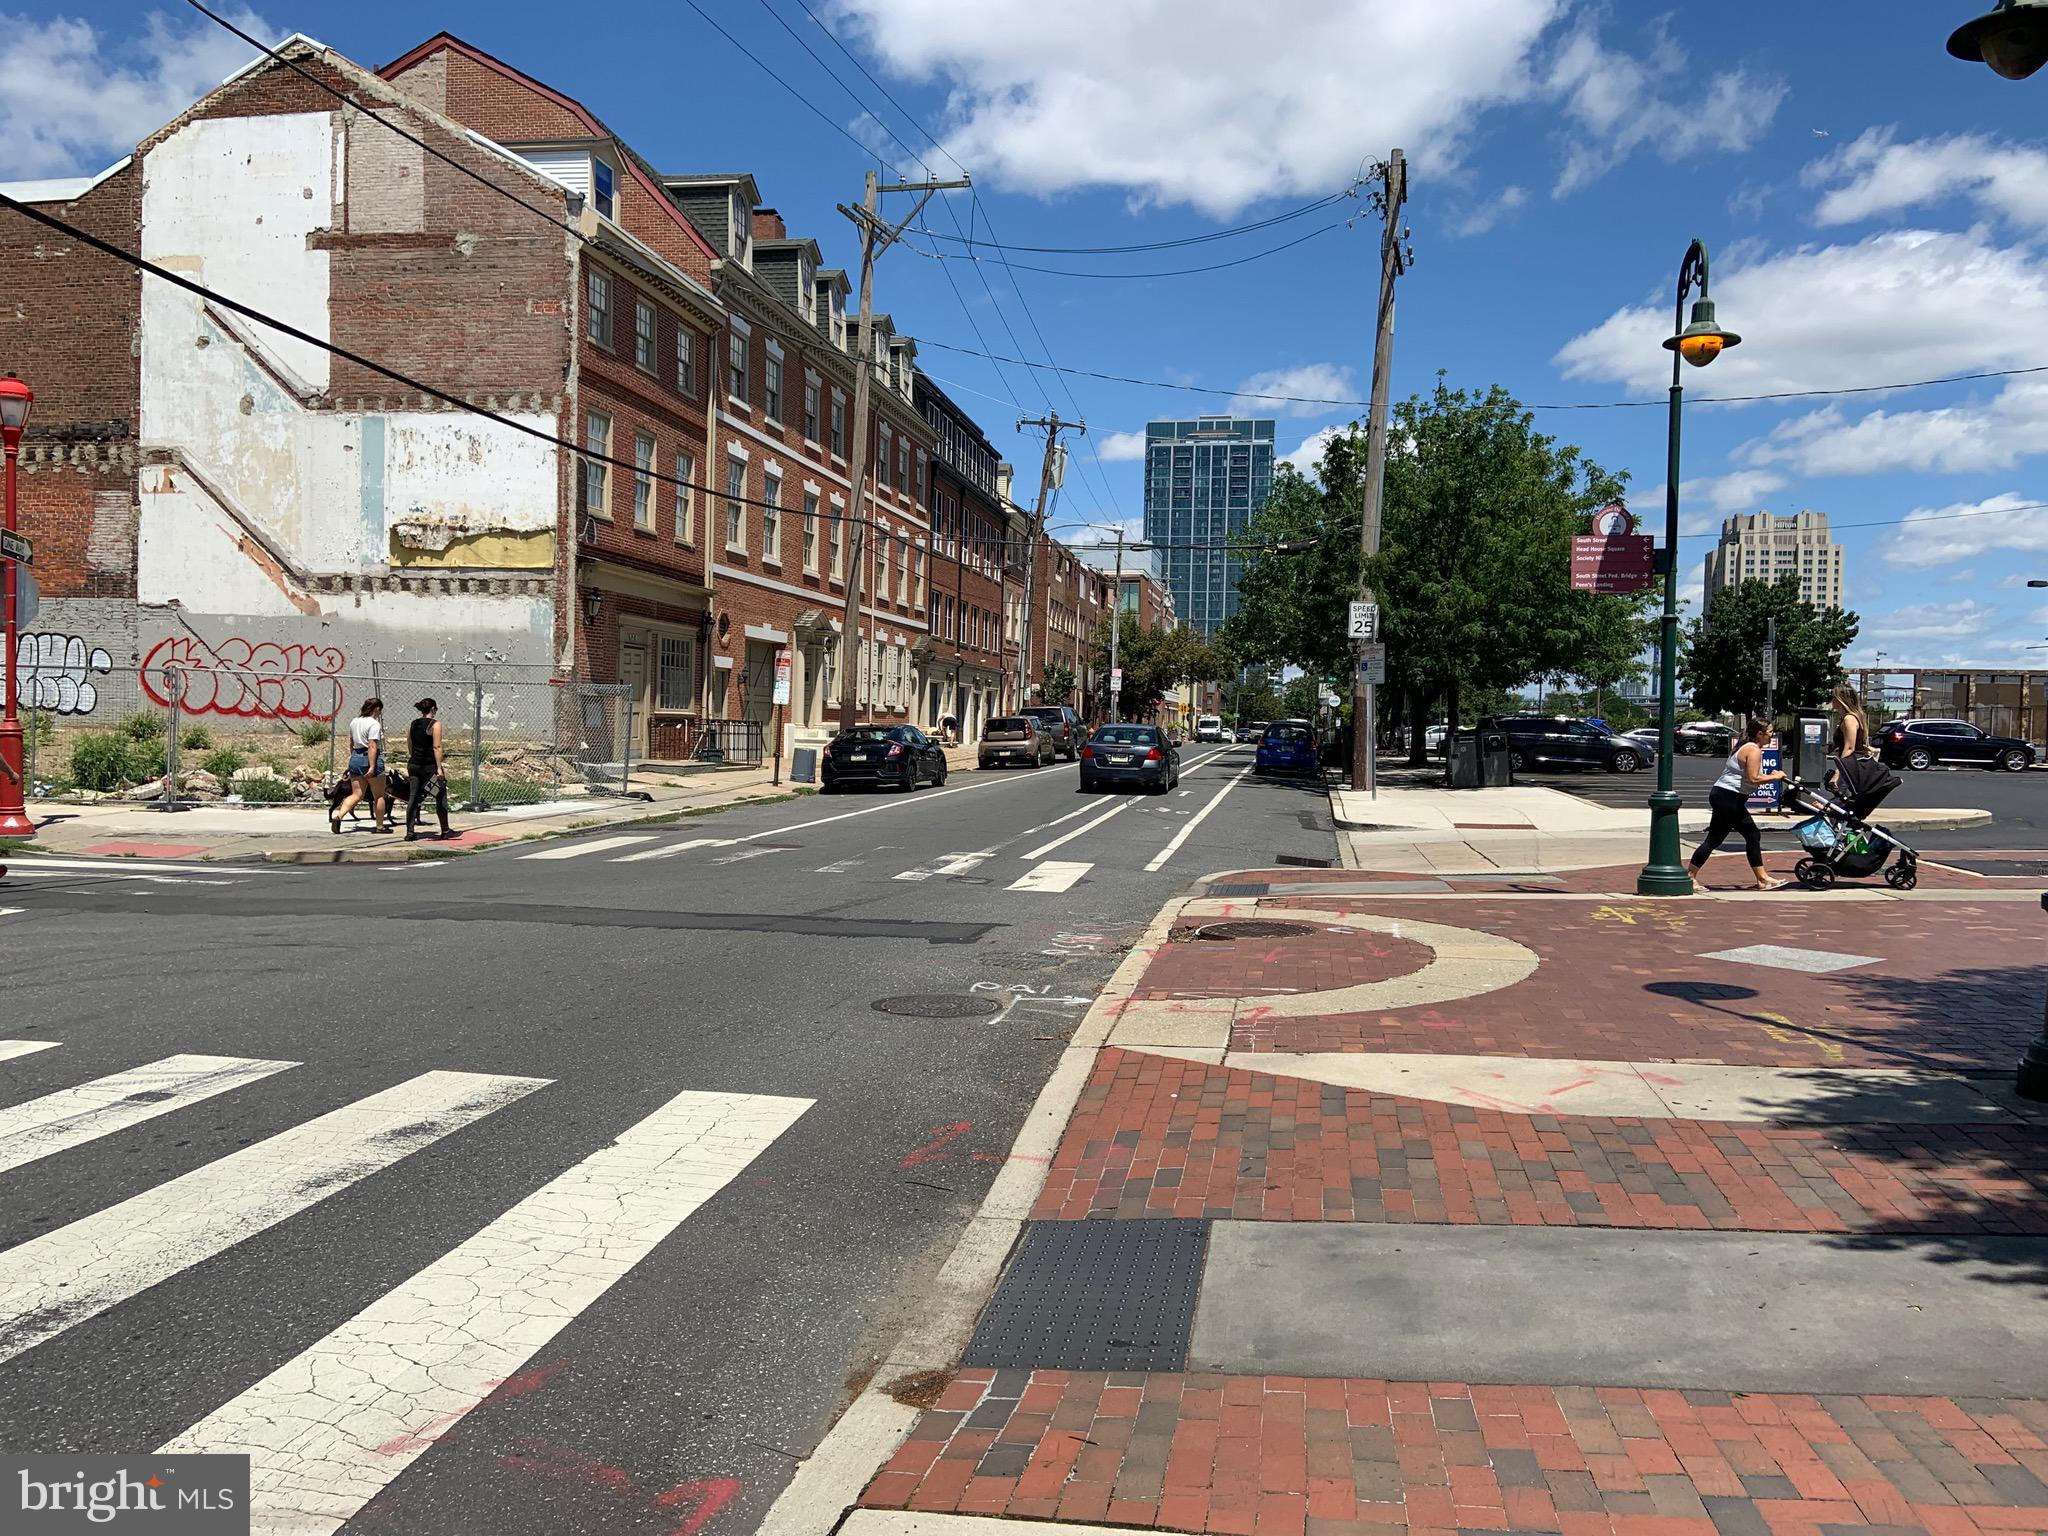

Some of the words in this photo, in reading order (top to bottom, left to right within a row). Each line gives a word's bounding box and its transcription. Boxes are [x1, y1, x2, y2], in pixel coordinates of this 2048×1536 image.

[1774, 521, 1797, 529] Hilton
[3, 537, 14, 550] ONE
[15, 542, 25, 555] WAY
[1354, 621, 1374, 633] 25
[1757, 789, 1777, 797] ONLY
